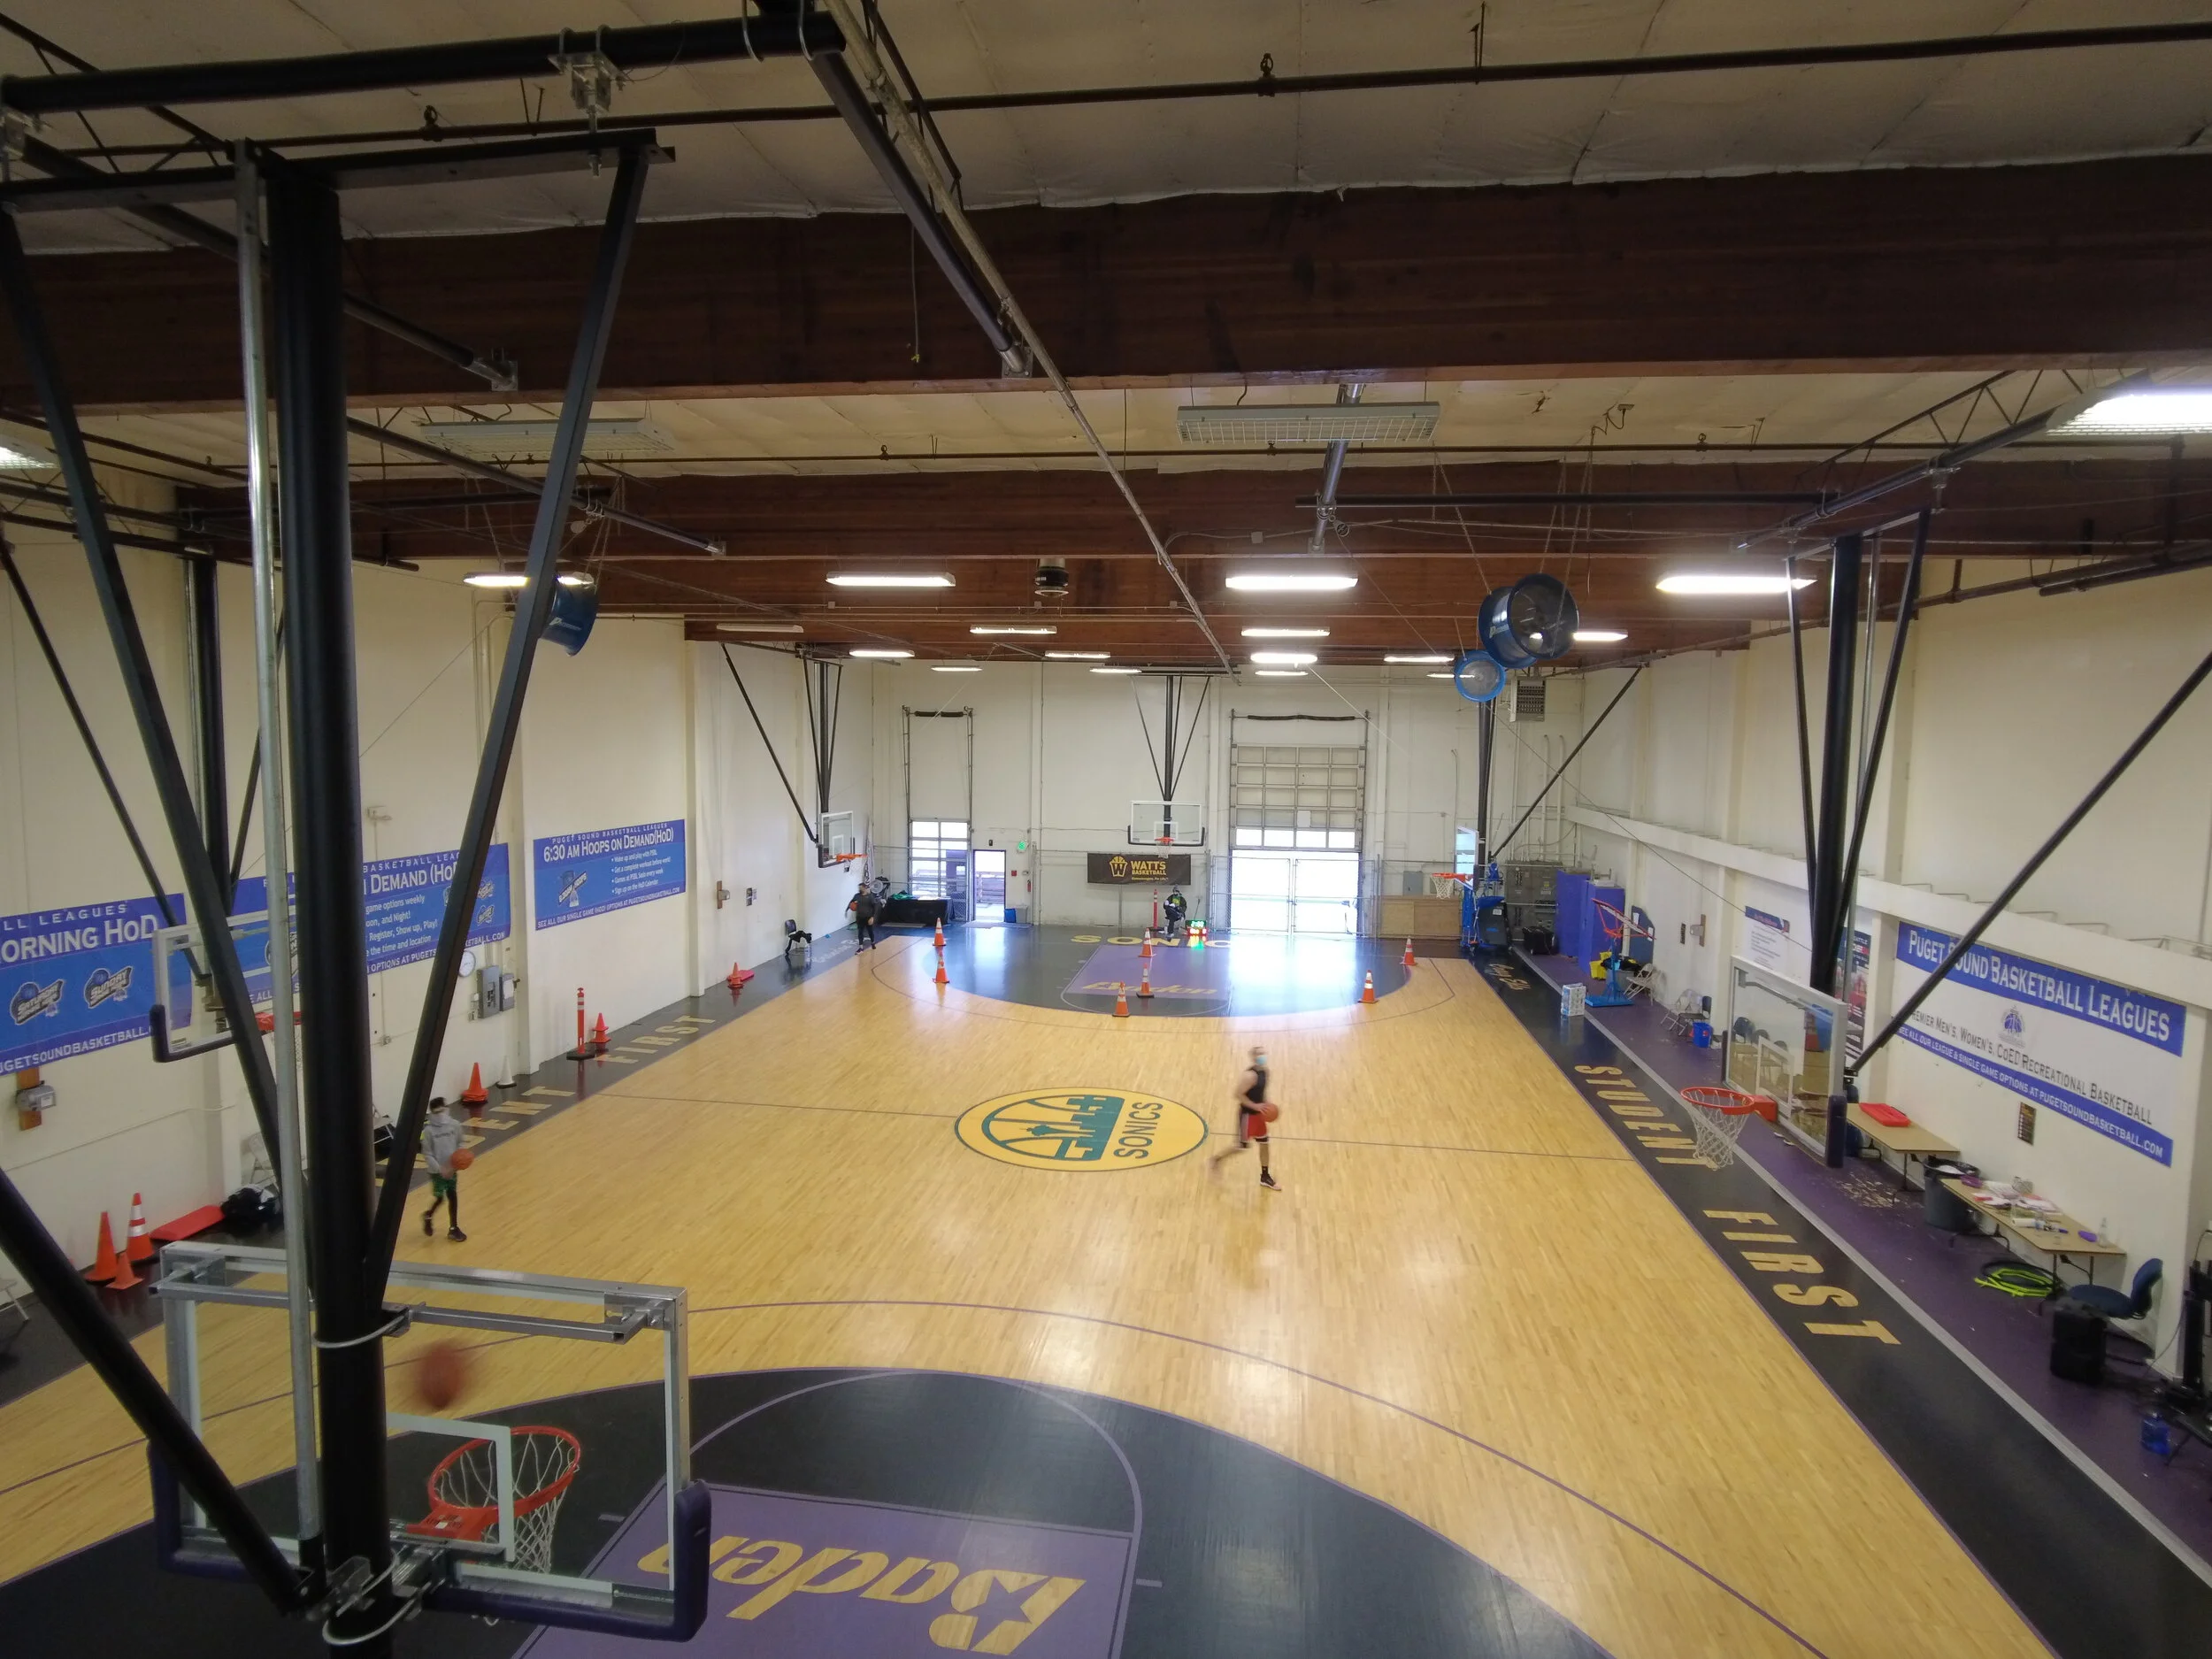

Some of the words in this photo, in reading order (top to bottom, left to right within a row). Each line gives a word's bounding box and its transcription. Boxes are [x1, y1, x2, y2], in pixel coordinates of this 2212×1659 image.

[552, 833, 574, 843] PUGET
[578, 832, 600, 841] SOUND
[602, 827, 641, 836] BASKETBALL
[543, 844, 565, 862] 6:30
[566, 844, 580, 858] AM
[581, 839, 610, 856] HOOPS
[611, 838, 622, 851] ON
[363, 856, 432, 873] BASKETBALL
[1131, 861, 1166, 870] WATTS
[370, 869, 427, 895] DEMAND
[39, 903, 128, 926] LEAGUES
[365, 904, 381, 915] game
[383, 899, 404, 910] options
[405, 895, 426, 904] weekly
[381, 914, 393, 924] and
[394, 910, 411, 923] Night!
[548, 918, 557, 926] ALL
[566, 910, 582, 921] SINGLE
[582, 908, 594, 917] GAME
[396, 926, 411, 935] Show
[382, 942, 396, 952] time
[397, 939, 408, 949] and
[410, 935, 432, 947] location
[372, 958, 401, 972] OPTIONS
[401, 956, 410, 964] AT
[1908, 929, 1946, 964] PUGET
[1991, 956, 2084, 1013] BASKETBALL
[2087, 985, 2170, 1041] LEAGUES
[257, 990, 273, 1002] ALL
[594, 1015, 716, 1064] FIRST
[1909, 1030, 1919, 1042] ALL
[1919, 1034, 1932, 1047] OUR
[1932, 1040, 1954, 1057] LEAGUE
[1958, 1053, 1980, 1071] SINGLE
[1980, 1063, 1999, 1079] GAME
[1999, 1071, 2029, 1094] OPTIONS
[2029, 1087, 2039, 1099] AT
[2039, 1090, 2163, 1158] PUGETSOUNDBASKETBALL.COM
[2023, 1053, 2087, 1096] RECREATIONAL
[2090, 1082, 2153, 1125] BASKETBALL
[1113, 1101, 1164, 1160] SONICS
[1574, 1064, 1715, 1169] STUDENT
[1702, 1210, 1901, 1346] FIRST
